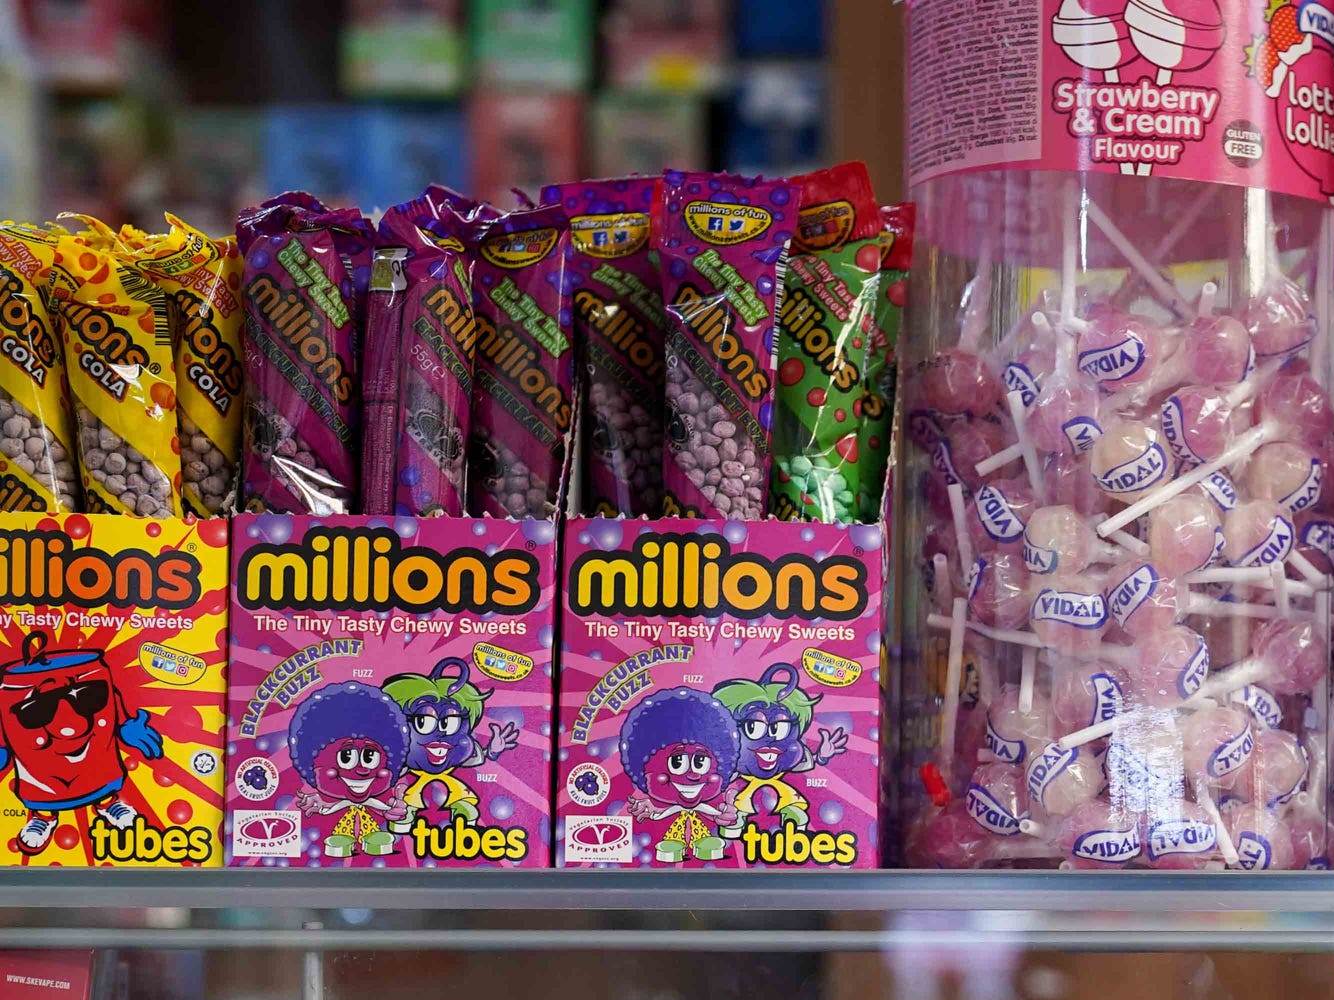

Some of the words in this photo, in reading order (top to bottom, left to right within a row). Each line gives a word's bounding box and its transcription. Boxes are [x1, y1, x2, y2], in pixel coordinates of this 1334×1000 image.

[1056, 85, 1217, 119] Strawberry
[1072, 111, 1096, 134] &
[1104, 108, 1201, 137] Cream
[1226, 128, 1262, 141] GLUTEN
[1094, 138, 1180, 161] Flavour
[1230, 142, 1256, 155] FREE
[689, 204, 731, 216] millions
[747, 209, 768, 220] fun
[248, 276, 355, 402] millions
[80, 352, 127, 399] COLA
[189, 365, 230, 414] COLA
[0, 538, 193, 601] illions
[246, 535, 531, 606] millions
[578, 541, 859, 612] millions
[17, 611, 62, 630] Tasty
[66, 612, 125, 631] Chewy
[130, 613, 193, 629] Sweets
[1040, 597, 1103, 618] VIDAL
[253, 615, 288, 631] The
[293, 616, 332, 635] Tiny
[337, 616, 385, 637] Tasty
[390, 616, 454, 637] Chewy
[459, 618, 527, 635] Sweets
[584, 621, 619, 637] The
[624, 621, 662, 641] Tiny
[668, 621, 715, 642] Tasty
[720, 622, 783, 643] Chewy
[788, 624, 855, 641] Sweets
[276, 666, 324, 708] BUZZ
[352, 668, 374, 678] FUZZ
[683, 674, 704, 684] FUZZ
[240, 638, 364, 738] BLACKCURRANT
[571, 645, 694, 744] BLACKCURRANT
[606, 671, 654, 713] BUZZ
[476, 773, 498, 783] BUZZ
[806, 778, 827, 788] BUZZ
[3, 809, 26, 817] COLA
[91, 817, 210, 860] tubes
[413, 818, 527, 859] tubes
[568, 839, 630, 853] APPROVED
[743, 822, 856, 863] tubes
[1078, 827, 1141, 857] VIDAL
